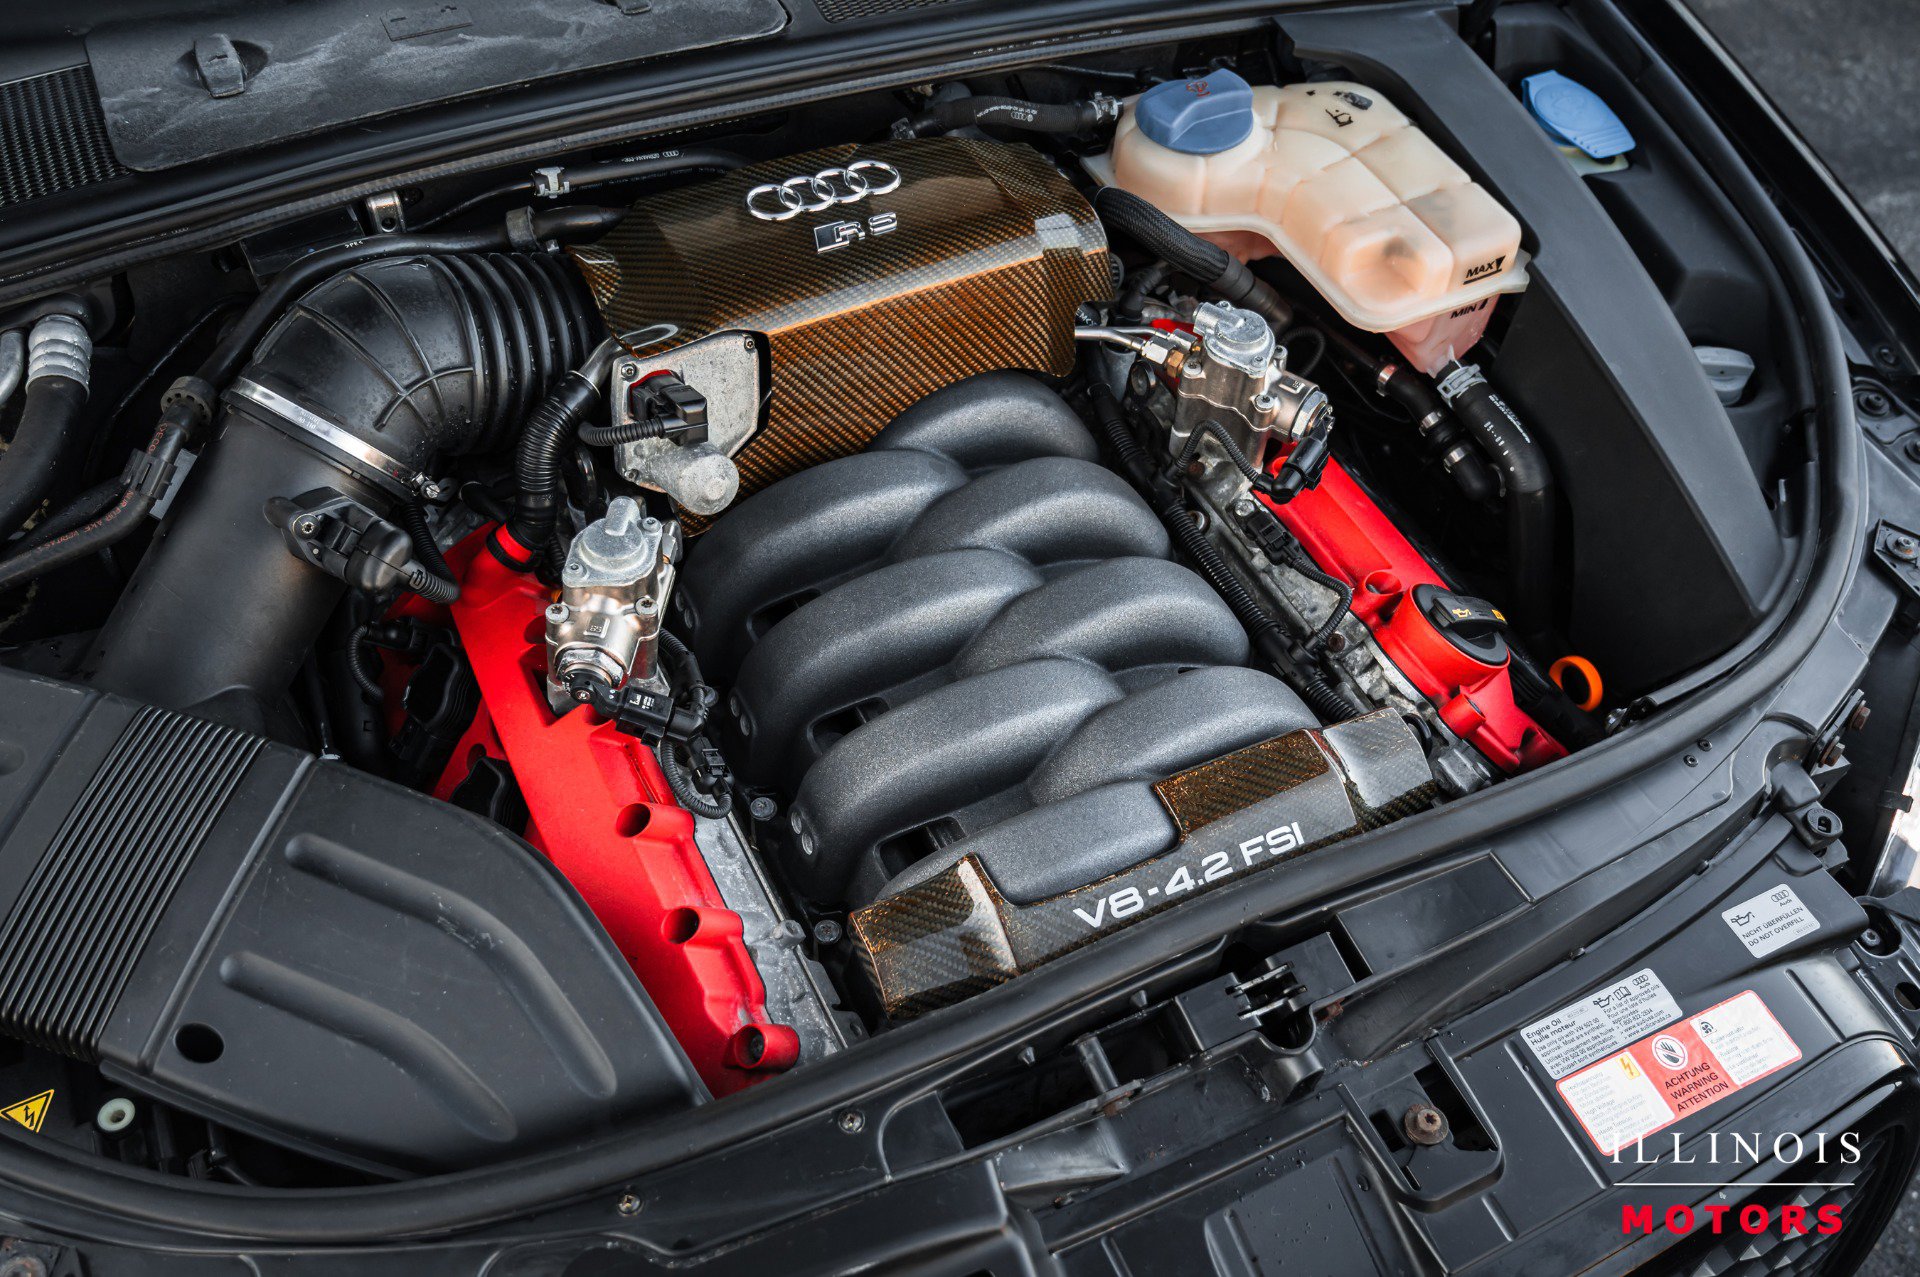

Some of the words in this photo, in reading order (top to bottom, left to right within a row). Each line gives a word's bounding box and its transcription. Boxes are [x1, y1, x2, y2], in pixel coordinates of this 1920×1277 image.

[1466, 260, 1495, 278] MAX
[1450, 304, 1477, 319] MIN
[1239, 822, 1305, 866] FSI
[1779, 899, 1793, 907] Audi
[1742, 925, 1763, 939] NICHT
[1763, 906, 1804, 929] ÜBERFÜLLEN
[1748, 938, 1760, 947] DO
[1760, 930, 1774, 941] NOT
[1774, 917, 1805, 934] OVERFILL
[1525, 1023, 1551, 1039] Engine
[1549, 1017, 1562, 1026] Oil
[1530, 1032, 1550, 1045] Huile
[1549, 1019, 1577, 1036] moteur
[1664, 1062, 1711, 1090] ACHTUNG
[1670, 1072, 1719, 1100] WARNING
[1677, 1081, 1729, 1112] ATTENTION
